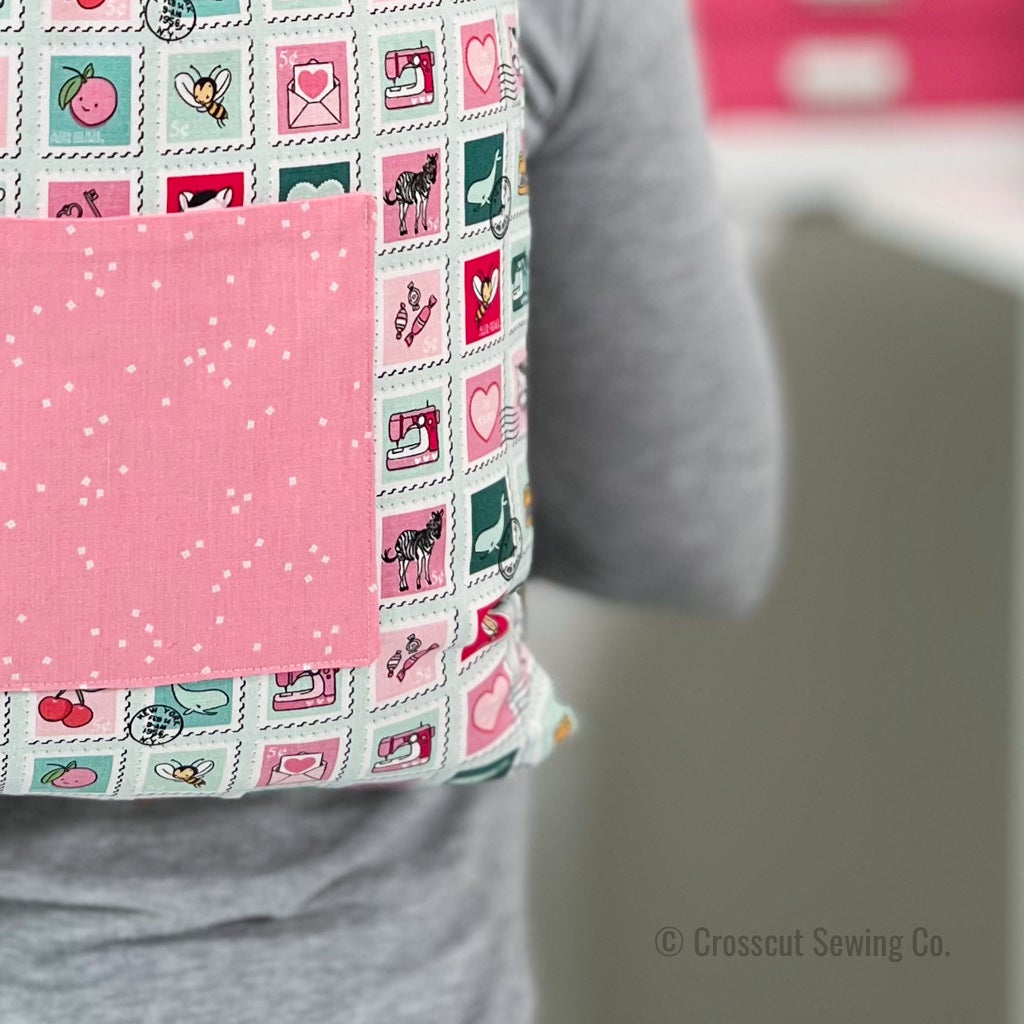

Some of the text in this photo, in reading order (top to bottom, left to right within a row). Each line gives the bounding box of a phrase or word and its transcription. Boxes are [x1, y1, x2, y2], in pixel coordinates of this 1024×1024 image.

[279, 49, 298, 68] 5¢
[170, 119, 189, 137] 5¢
[137, 707, 158, 720] NEW
